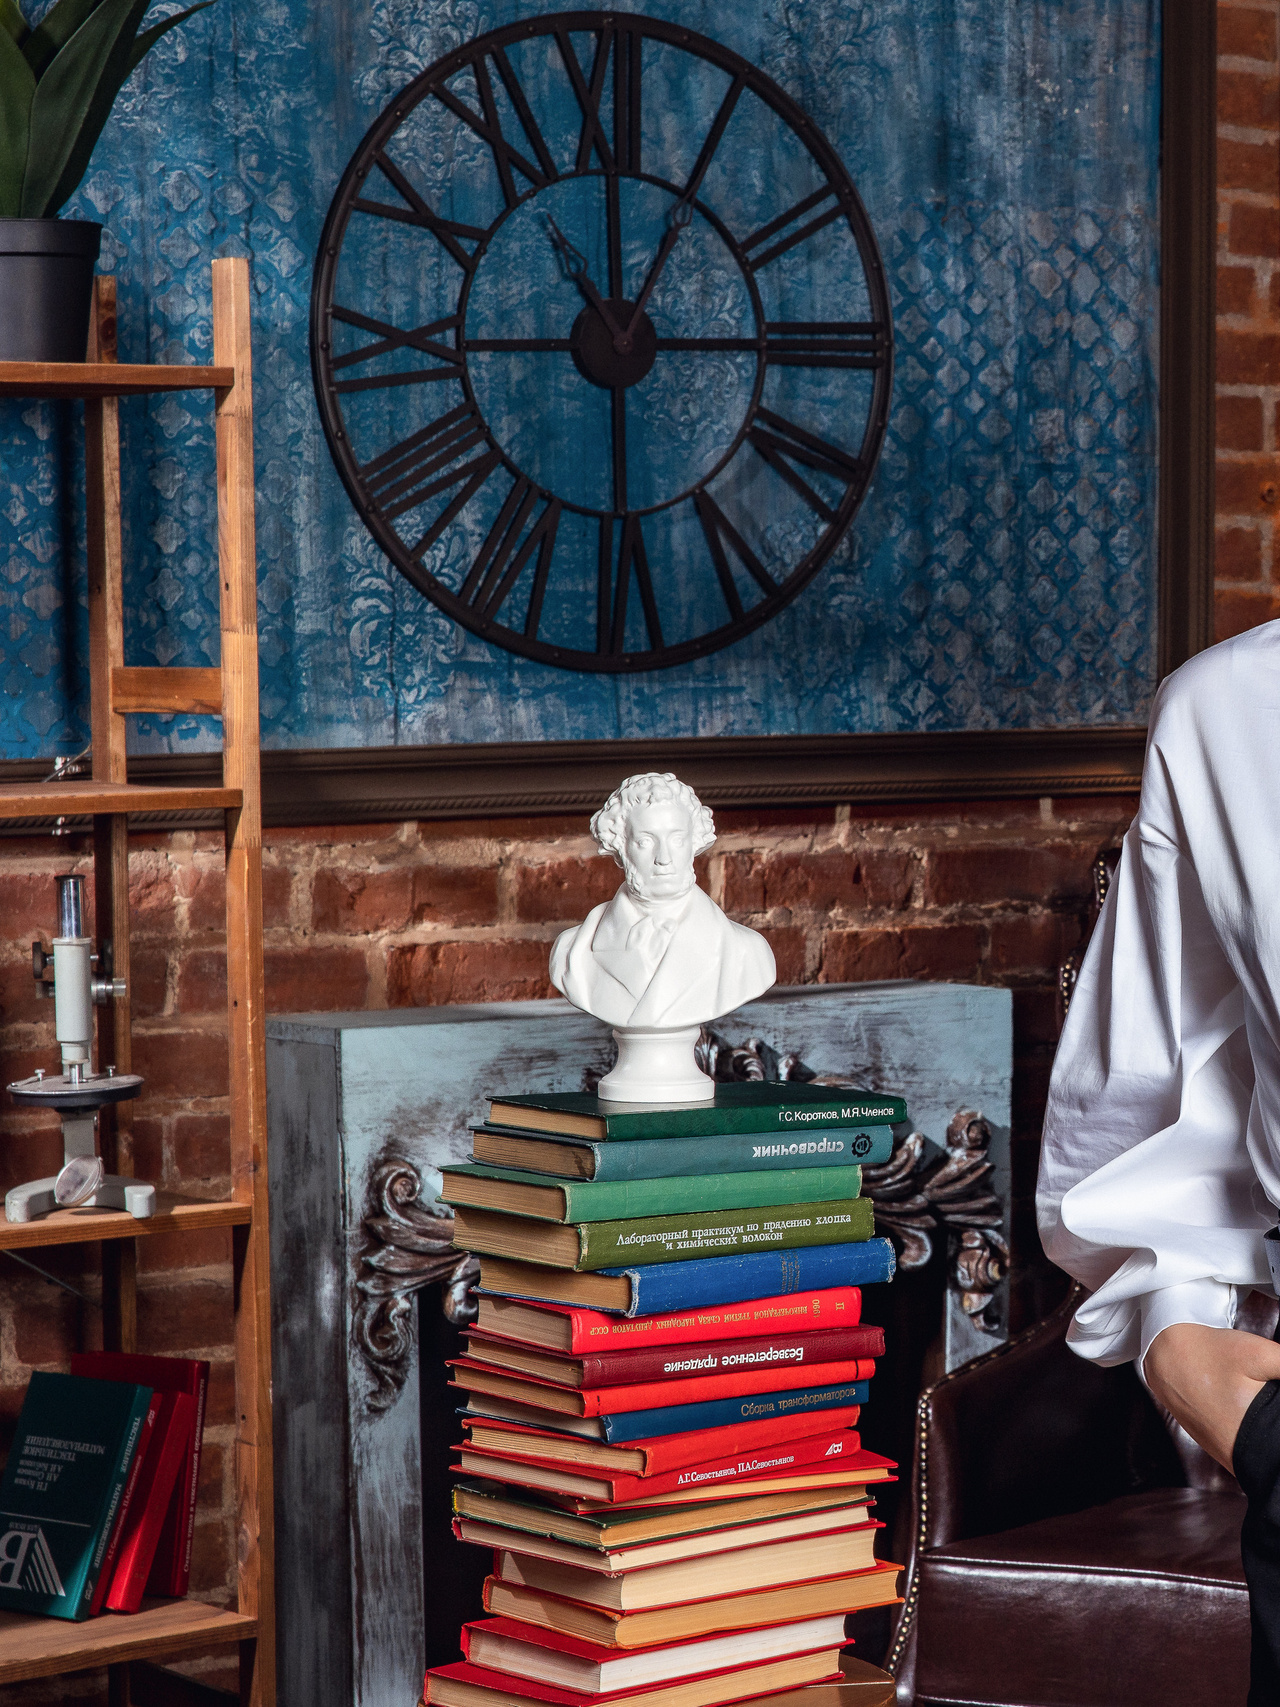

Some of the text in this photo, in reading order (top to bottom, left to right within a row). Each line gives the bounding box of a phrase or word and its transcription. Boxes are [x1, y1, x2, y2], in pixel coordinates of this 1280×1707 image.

[778, 1107, 894, 1122] Г.С.Коротков, М.Я.Членов
[752, 1138, 845, 1158] справочник
[616, 1214, 852, 1246] Лабораторный практикум по прядению хлопка
[665, 1231, 784, 1250] и химических волокон
[590, 1326, 609, 1336] СССР
[612, 1320, 653, 1334] ДЕПУТАТОВ
[664, 1347, 804, 1373] Безверетенное прядение
[741, 1387, 856, 1416] Сборка трансформаторов
[120, 1416, 141, 1474] ТЕКСТИЛЬНОЕ
[677, 1455, 795, 1484] А.Г.Севостьянов, П.А.Севостьянов
